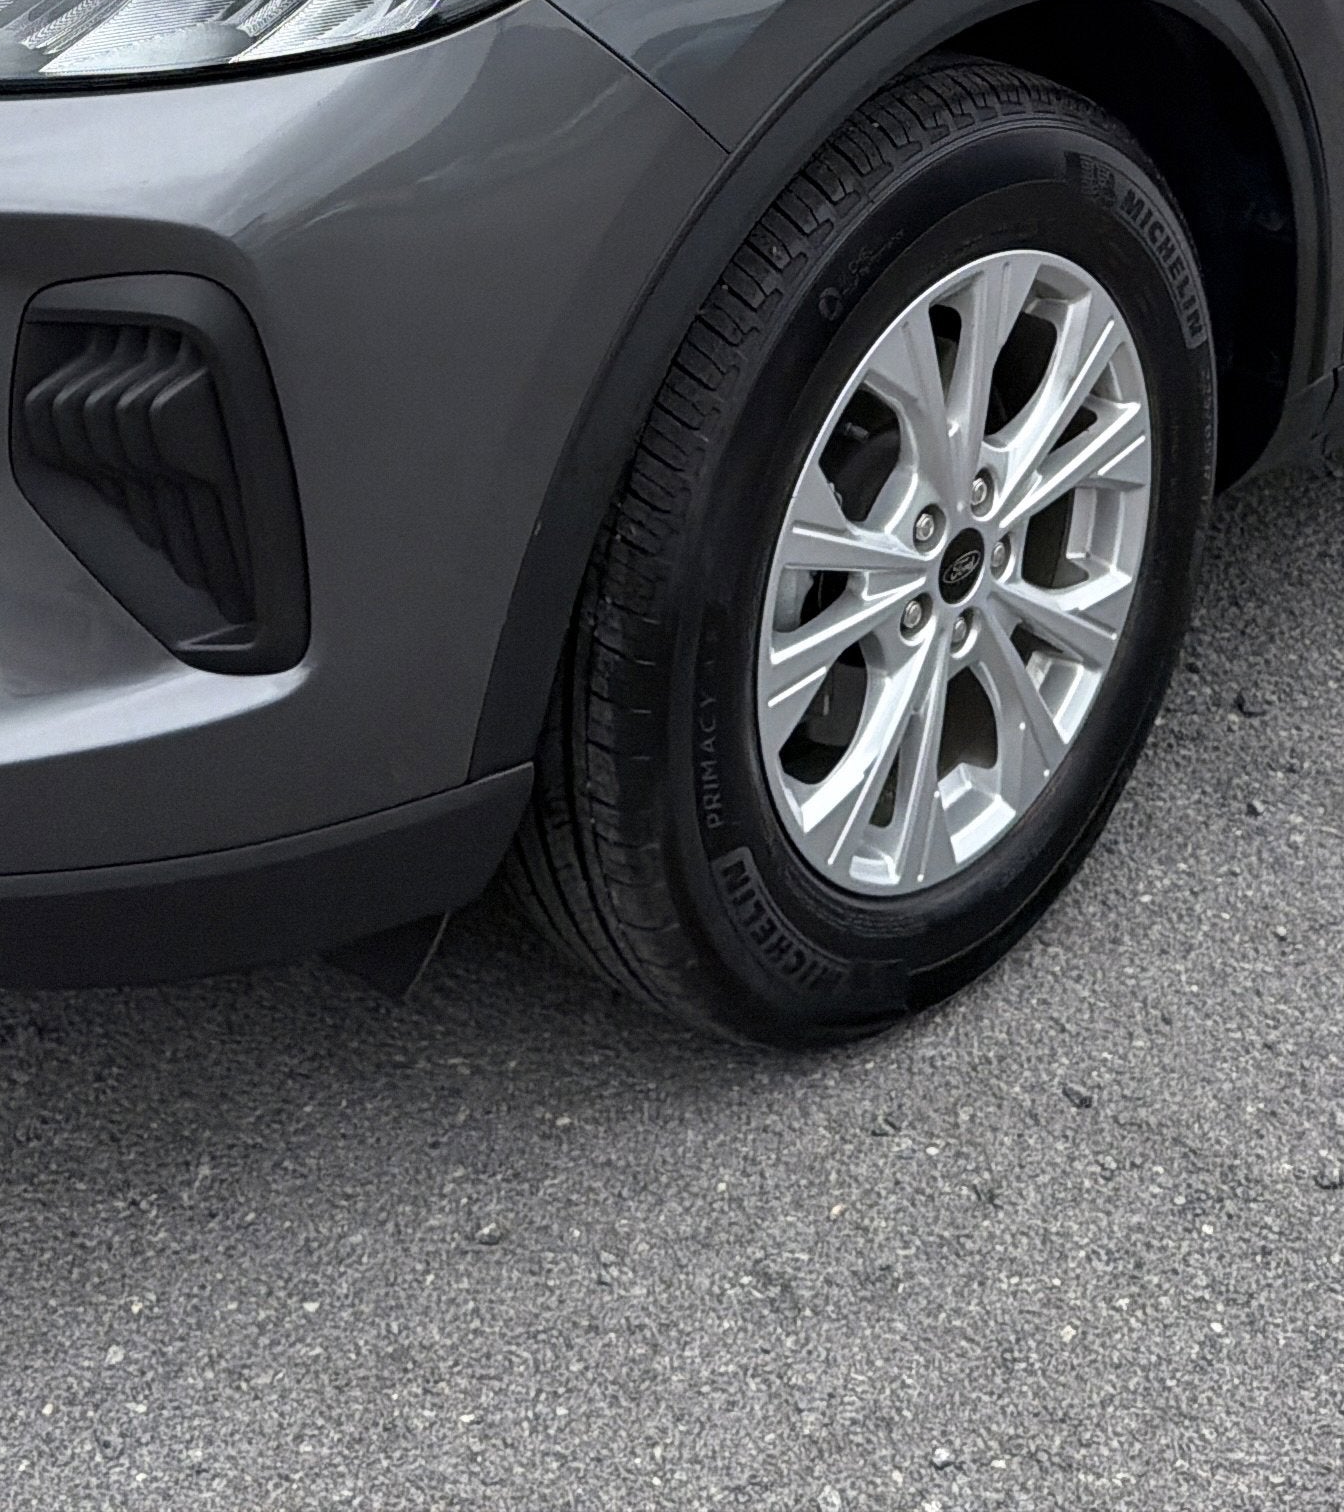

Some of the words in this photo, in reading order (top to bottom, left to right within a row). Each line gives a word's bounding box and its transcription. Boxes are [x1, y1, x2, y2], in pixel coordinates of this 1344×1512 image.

[1119, 188, 1204, 338] MICHELIN
[699, 692, 723, 830] PRIMACY
[721, 858, 848, 989] MICHELIN
